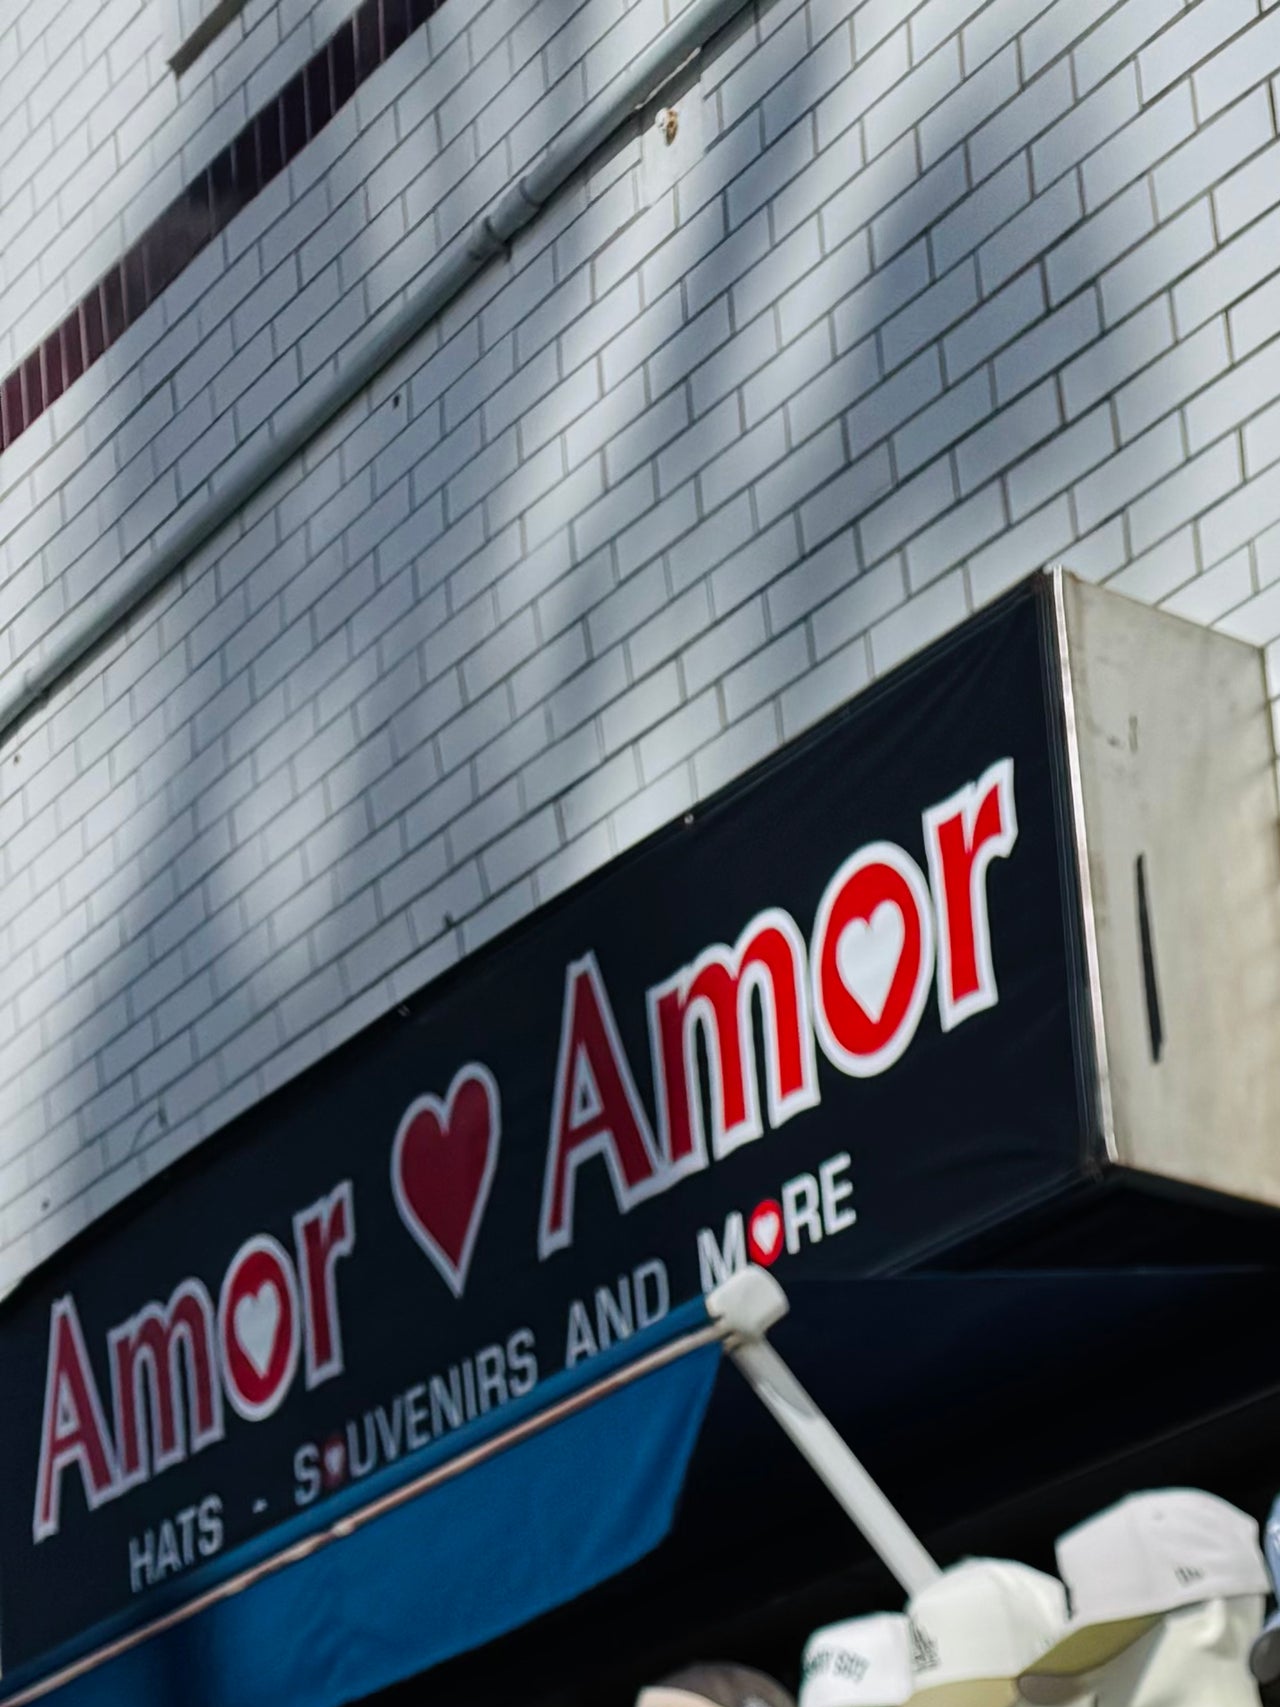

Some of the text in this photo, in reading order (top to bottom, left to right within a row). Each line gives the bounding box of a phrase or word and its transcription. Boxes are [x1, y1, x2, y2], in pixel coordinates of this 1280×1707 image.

[32, 757, 1019, 1544] Amor Amor
[128, 1493, 224, 1593] HATS
[293, 1328, 541, 1507] SOUVENIRS
[564, 1258, 671, 1375] AND
[696, 1153, 858, 1294] MORE
